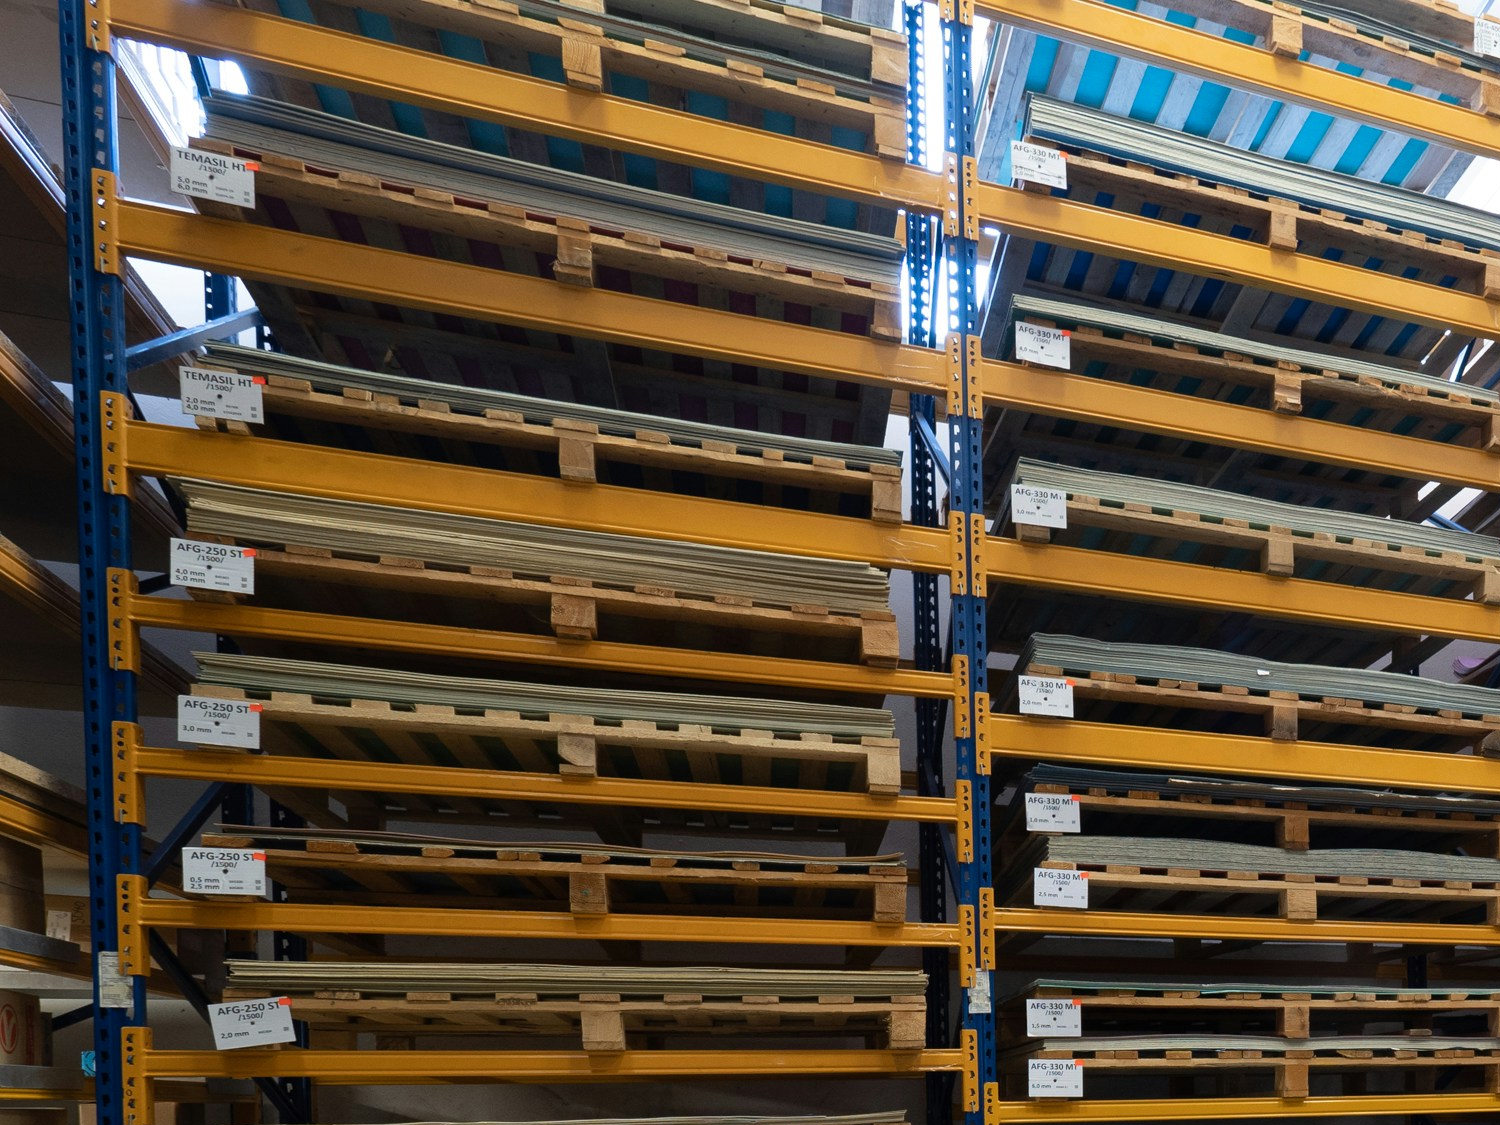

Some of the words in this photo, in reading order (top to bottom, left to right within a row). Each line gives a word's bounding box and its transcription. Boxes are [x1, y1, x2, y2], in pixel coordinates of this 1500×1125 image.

[1013, 144, 1047, 158] AFG-330
[176, 150, 229, 169] TEMASIL
[199, 164, 227, 175] /1500/
[178, 176, 190, 185] 5,0
[192, 180, 208, 188] mm
[192, 187, 208, 195] mm
[1019, 325, 1051, 339] AFG-330
[184, 370, 235, 386] TEMASIL
[238, 378, 253, 388] HT
[206, 383, 233, 393] /1500/
[186, 396, 198, 405] 2,0
[186, 403, 199, 412] 4,0
[1015, 488, 1048, 498] AFG-330
[177, 542, 227, 557] AFG-250
[230, 549, 244, 559] ST
[197, 554, 224, 564] /1500/
[175, 568, 188, 576] 4,0
[175, 574, 188, 583] 5,0
[184, 699, 234, 713] AFG-250
[236, 705, 250, 714] ST
[203, 710, 231, 720] /1500/
[182, 725, 195, 733] 3,0
[1028, 796, 1061, 805] AFG-330
[191, 851, 240, 861] AFG-250
[243, 853, 255, 861] ST
[1038, 871, 1071, 880] AFG-330
[190, 883, 202, 891] 2,5
[217, 1003, 265, 1015] AFG-250
[268, 1001, 280, 1010] ST
[1030, 1002, 1063, 1010] AFG-330
[238, 1013, 264, 1021] /1500/
